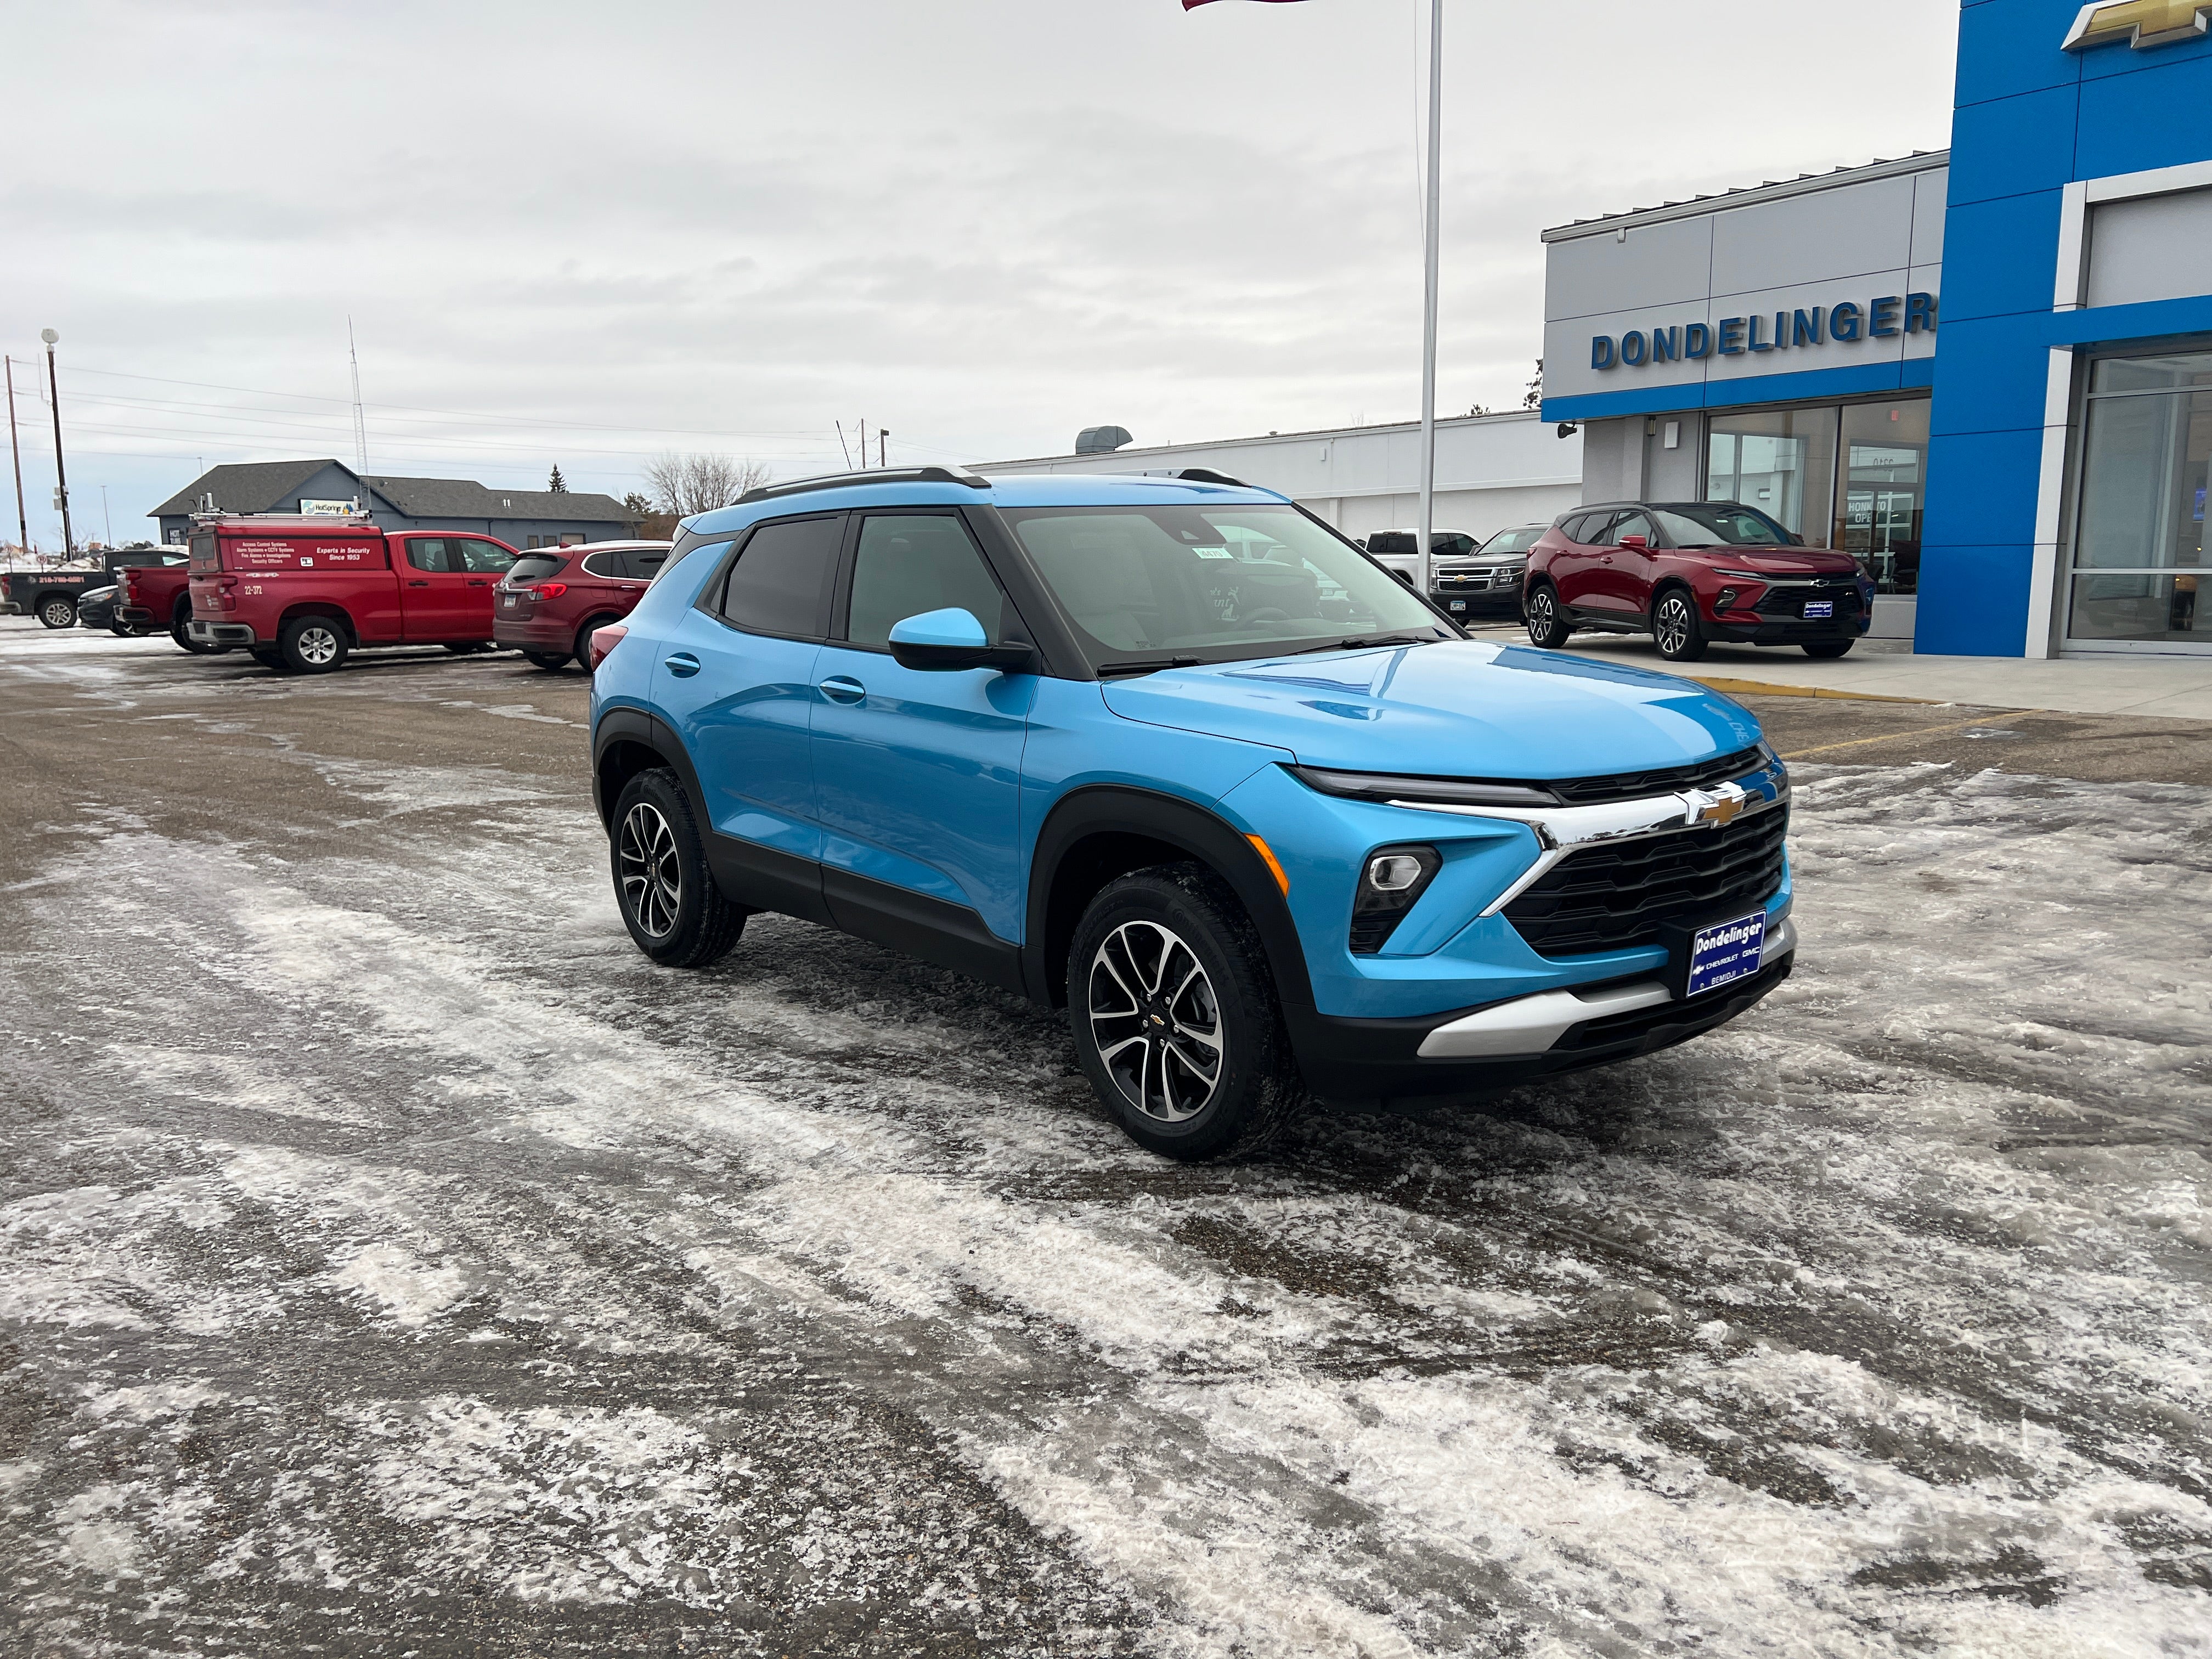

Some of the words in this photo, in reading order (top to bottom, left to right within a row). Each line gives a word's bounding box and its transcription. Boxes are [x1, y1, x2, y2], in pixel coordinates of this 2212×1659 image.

[1591, 292, 1936, 370] DONDELINGER
[1696, 922, 1762, 955] Dondelinger
[1706, 953, 1739, 970] CHEVROLET
[1742, 946, 1760, 957] GMC
[1711, 970, 1736, 985] BEMIDJI
